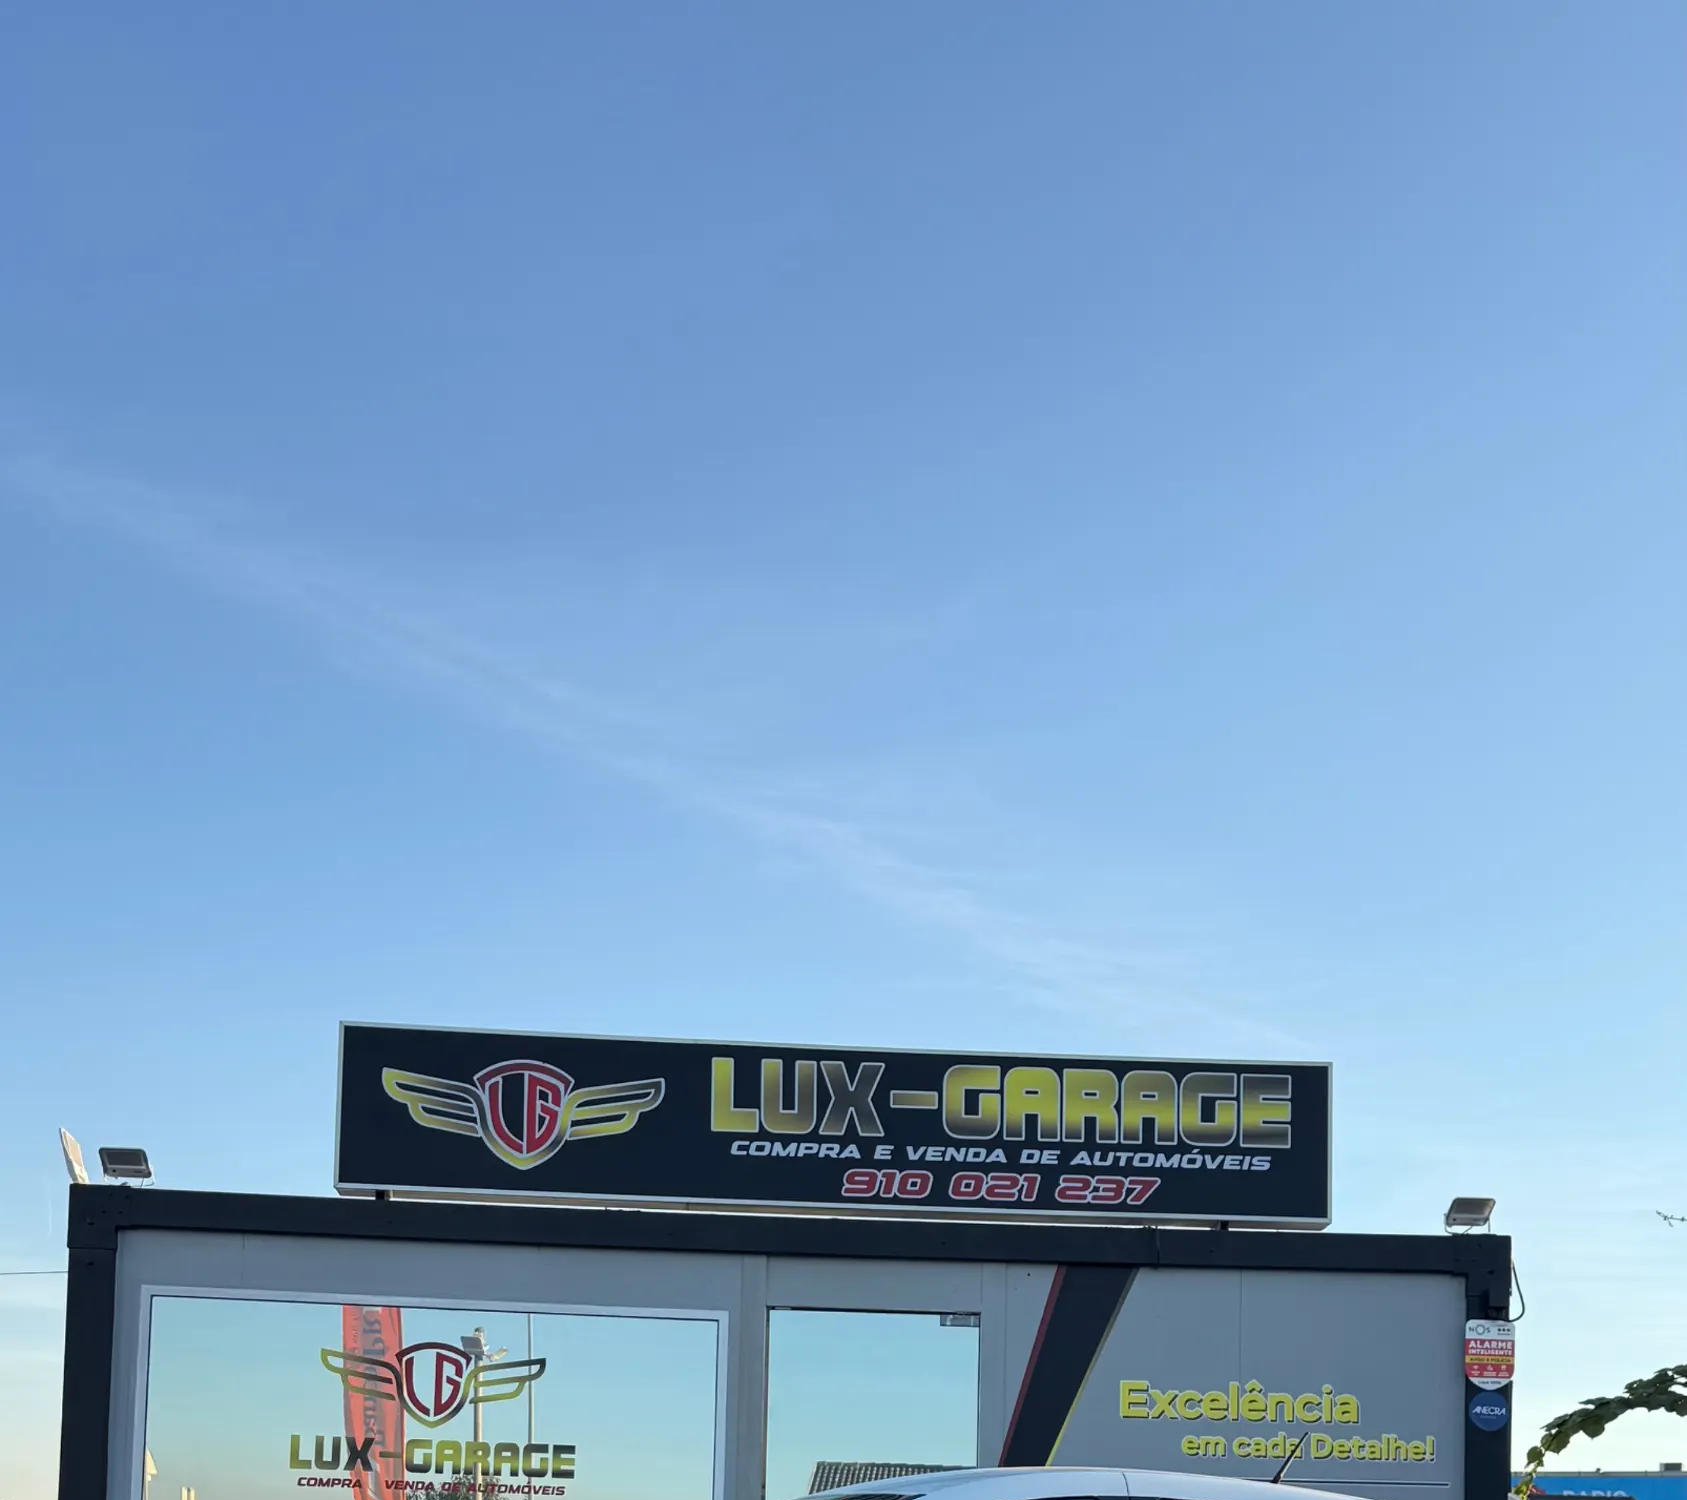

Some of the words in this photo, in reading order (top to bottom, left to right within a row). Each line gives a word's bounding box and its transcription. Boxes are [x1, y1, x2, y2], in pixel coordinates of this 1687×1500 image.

[711, 1057, 1291, 1148] LUX-GARAGE
[730, 1140, 861, 1160] COMPRA
[874, 1145, 894, 1160] E
[906, 1146, 1007, 1163] VENDA
[1020, 1149, 1061, 1165] DE
[1070, 1149, 1272, 1171] AUTOMÓVEIS
[841, 1169, 933, 1198] 910
[949, 1171, 1041, 1202] 021
[1055, 1175, 1161, 1205] 237
[1468, 1340, 1513, 1349] ALARME
[1119, 1379, 1360, 1424] Excelência
[1472, 1406, 1506, 1415] ANECRA
[289, 1434, 576, 1479] LUX-GARAGE
[1181, 1435, 1227, 1458] em
[1232, 1431, 1303, 1459] cada
[1310, 1433, 1436, 1463] Detalhe!
[297, 1477, 363, 1489] COMPRA
[385, 1480, 434, 1492] VENDA
[441, 1482, 462, 1493] DE
[466, 1481, 566, 1496] AUTOMÓVEIS
